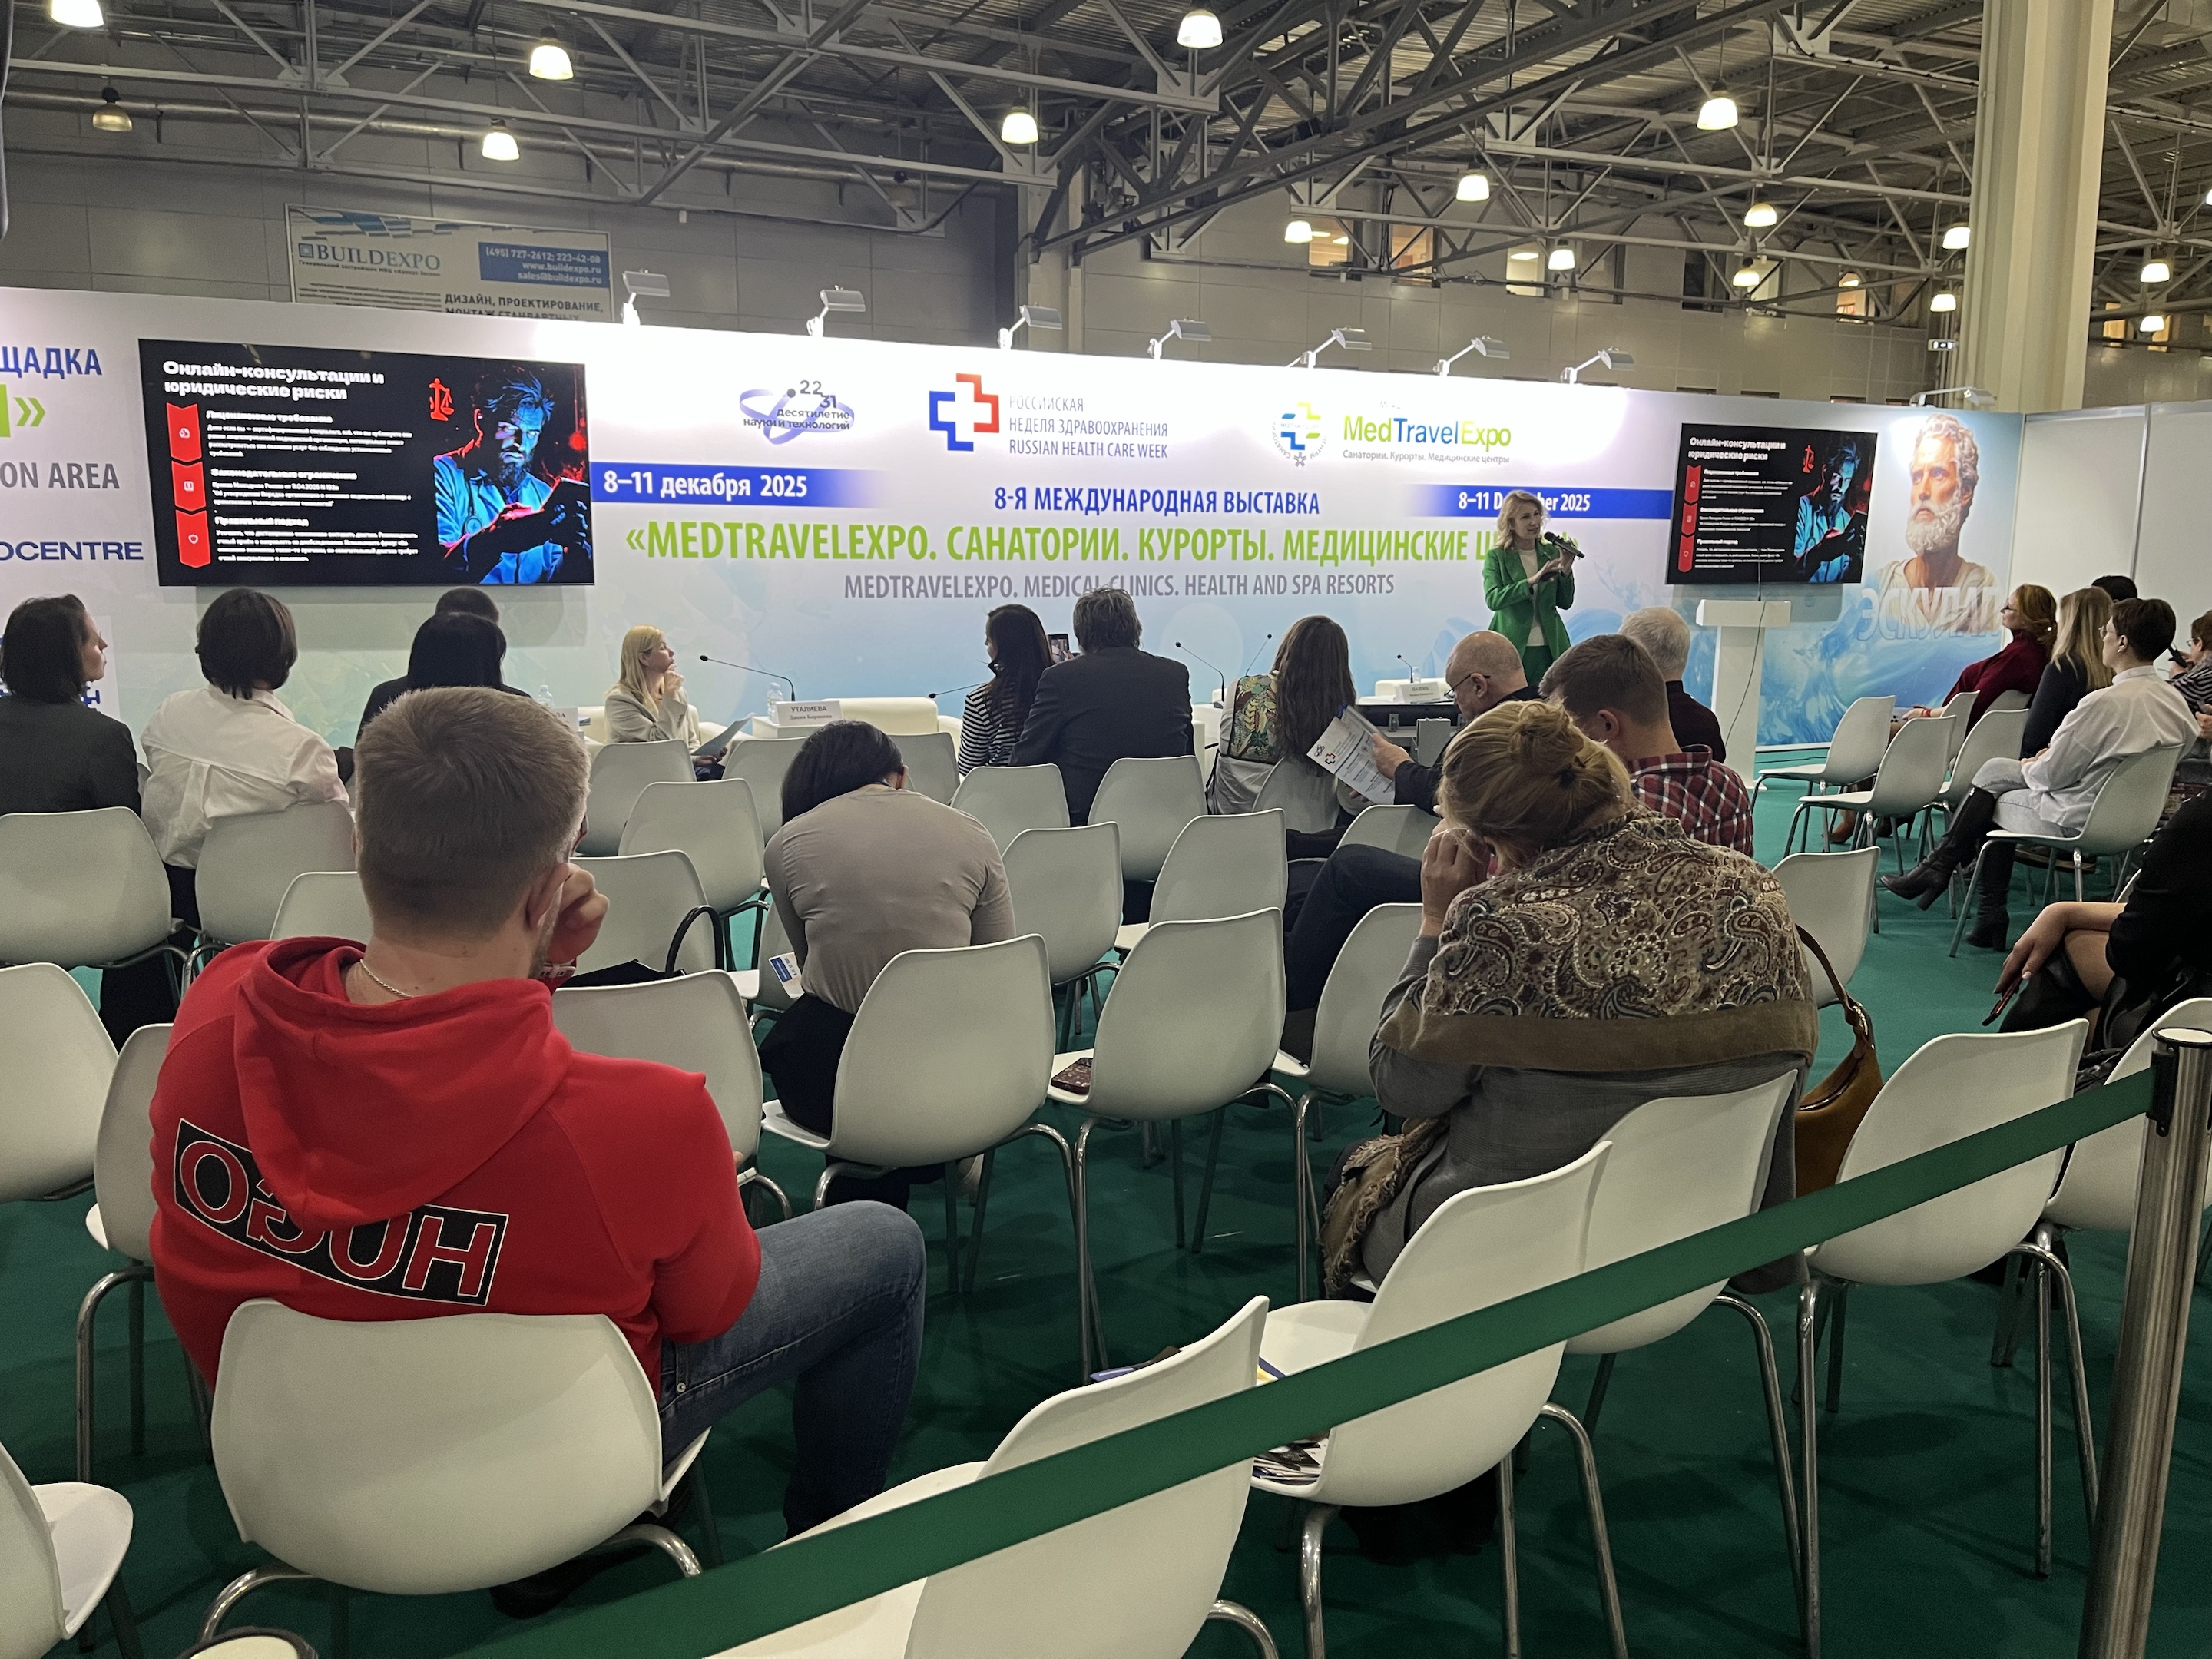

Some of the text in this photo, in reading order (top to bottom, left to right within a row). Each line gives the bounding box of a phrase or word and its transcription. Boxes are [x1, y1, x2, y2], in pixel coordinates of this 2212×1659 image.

[316, 243, 440, 270] BUILDEXPO
[518, 271, 602, 283] sales@buildexpo.ru
[522, 261, 601, 274] www.buildexpo.ru
[445, 293, 495, 306] ДИЗАЙН,
[498, 296, 604, 313] ПРОЕКТИРОВАНИЕ,
[163, 360, 385, 386] Онлайн-консультации и
[164, 380, 348, 402] юридические риски
[800, 379, 822, 396] 22
[819, 395, 837, 409] 31
[777, 409, 850, 419] десятилетие
[743, 419, 777, 429] науки
[787, 420, 850, 430] технологий
[1009, 417, 1168, 437] НЕДЕЛЯ ЗДРАВООХРАНЕНИЯ
[1343, 415, 1512, 452] MedTravelExpo
[1009, 439, 1168, 459] RUSSIAN HEALTH CARE WEEK
[1689, 436, 1780, 452] Онлайн-консультации
[1343, 449, 1510, 464] Санатории. Курорты. Медицинские центры
[1687, 450, 1768, 462] юридические риски
[0, 462, 120, 488] ON AREA
[661, 472, 751, 502] декабря
[760, 474, 808, 498] 2025
[994, 486, 1320, 517] 8-Я МЕЖДУНАРОДНАЯ ВЫСТАВКА
[1560, 493, 1591, 512] 2025
[626, 521, 937, 561] «MEDTRAVELEXPO.
[946, 525, 1129, 561] САНАТОРИИ.
[1138, 528, 1274, 561] КУРОРТЫ.
[1283, 529, 1467, 567] МЕДИЦИНСКИЕ
[844, 574, 1018, 598] MEDTRAVELEXPO.
[1184, 574, 1249, 597] HEALTH
[1253, 574, 1288, 596] AND
[1292, 573, 1322, 595] SPA
[1326, 573, 1395, 595] RESORTS
[1856, 586, 2003, 641] ЭСКУЛАП
